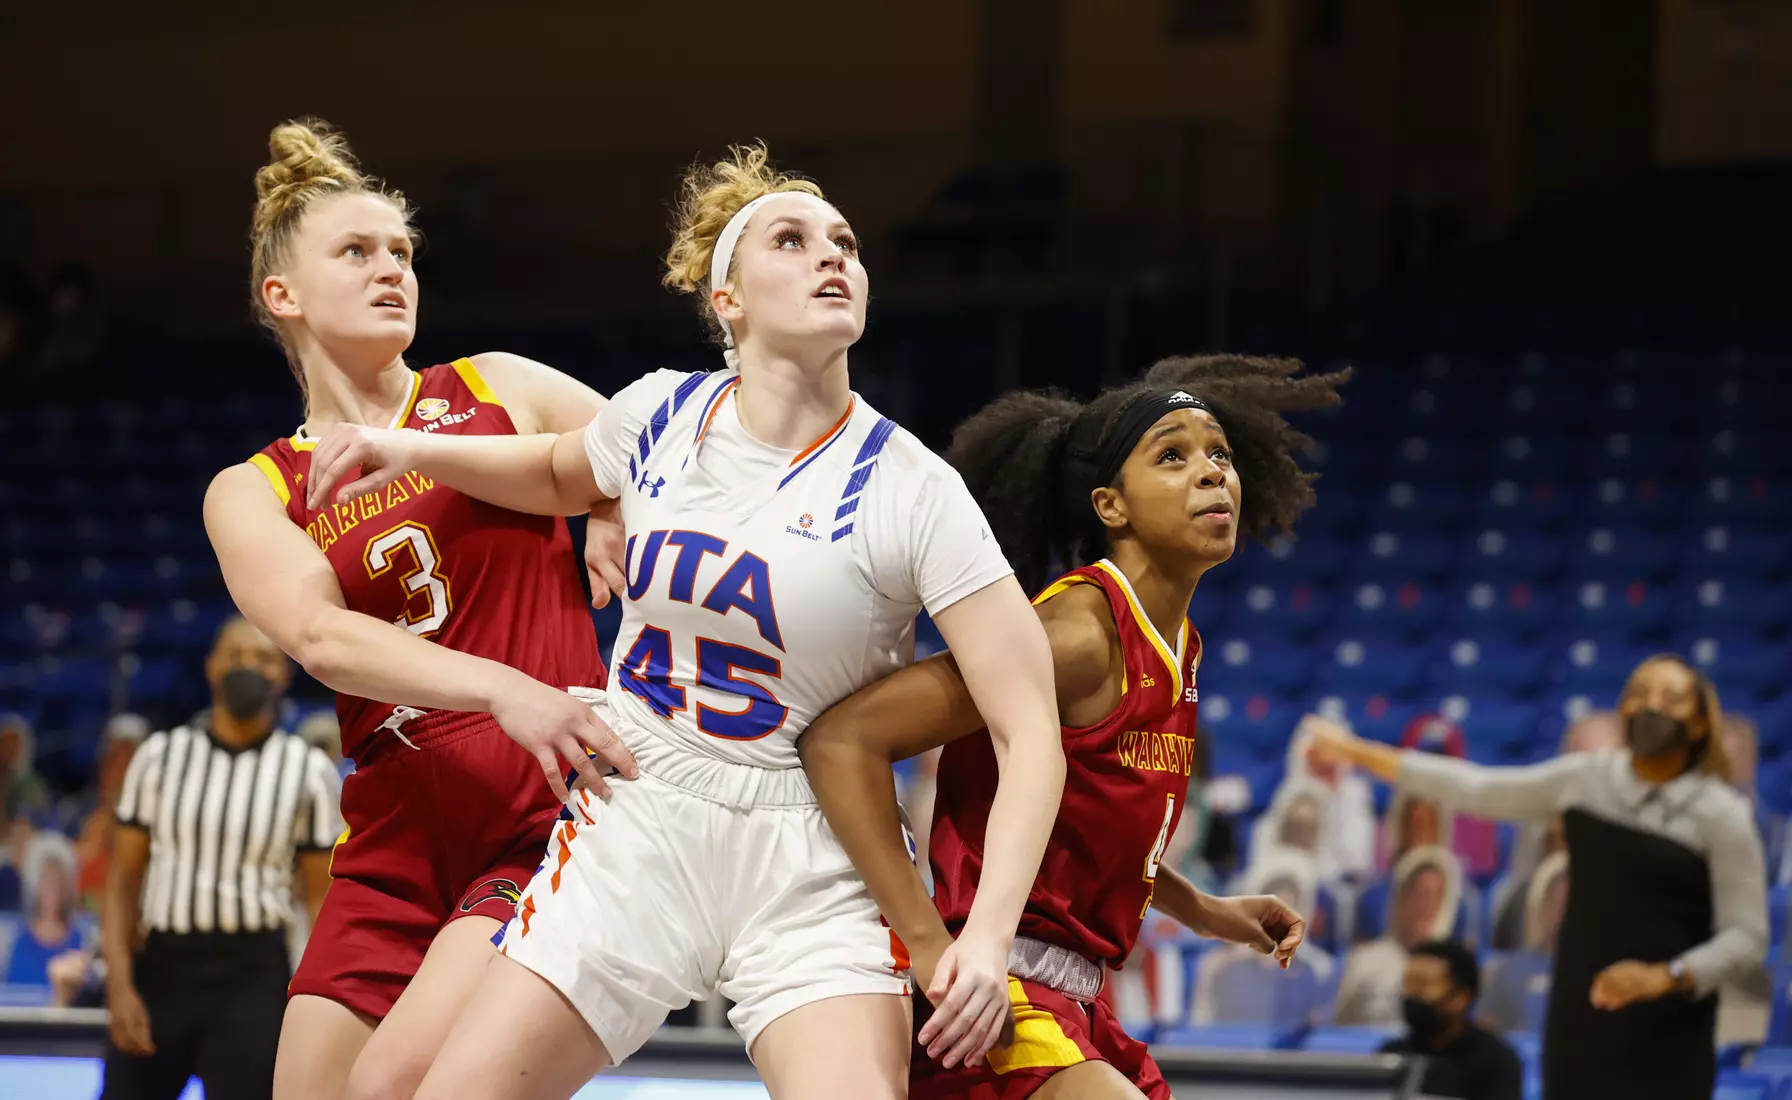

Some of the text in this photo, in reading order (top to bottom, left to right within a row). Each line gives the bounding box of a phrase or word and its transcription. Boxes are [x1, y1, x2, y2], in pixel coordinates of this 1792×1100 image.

[440, 407, 476, 426] BELT
[363, 519, 453, 638] 3
[625, 529, 787, 654] UTA
[786, 525, 820, 541] SUN BELT
[617, 623, 789, 741] 45
